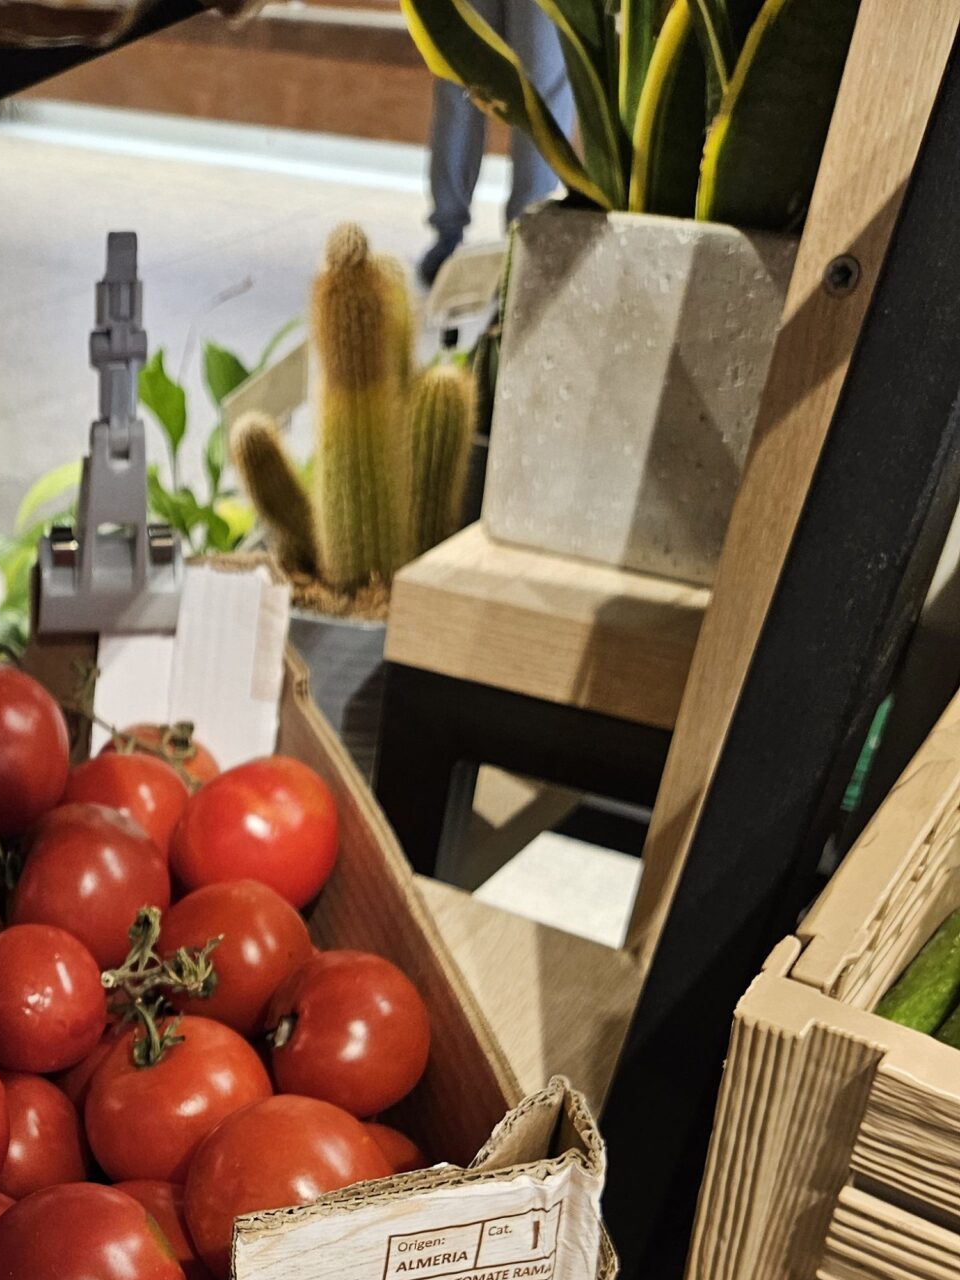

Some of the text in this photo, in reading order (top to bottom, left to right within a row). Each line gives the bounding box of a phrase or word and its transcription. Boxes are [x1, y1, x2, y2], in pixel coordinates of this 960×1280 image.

[488, 1225, 513, 1236] Cat.
[397, 1237, 446, 1253] Origen:
[395, 1250, 468, 1273] ALMERIA
[512, 1264, 552, 1279] RAMA
